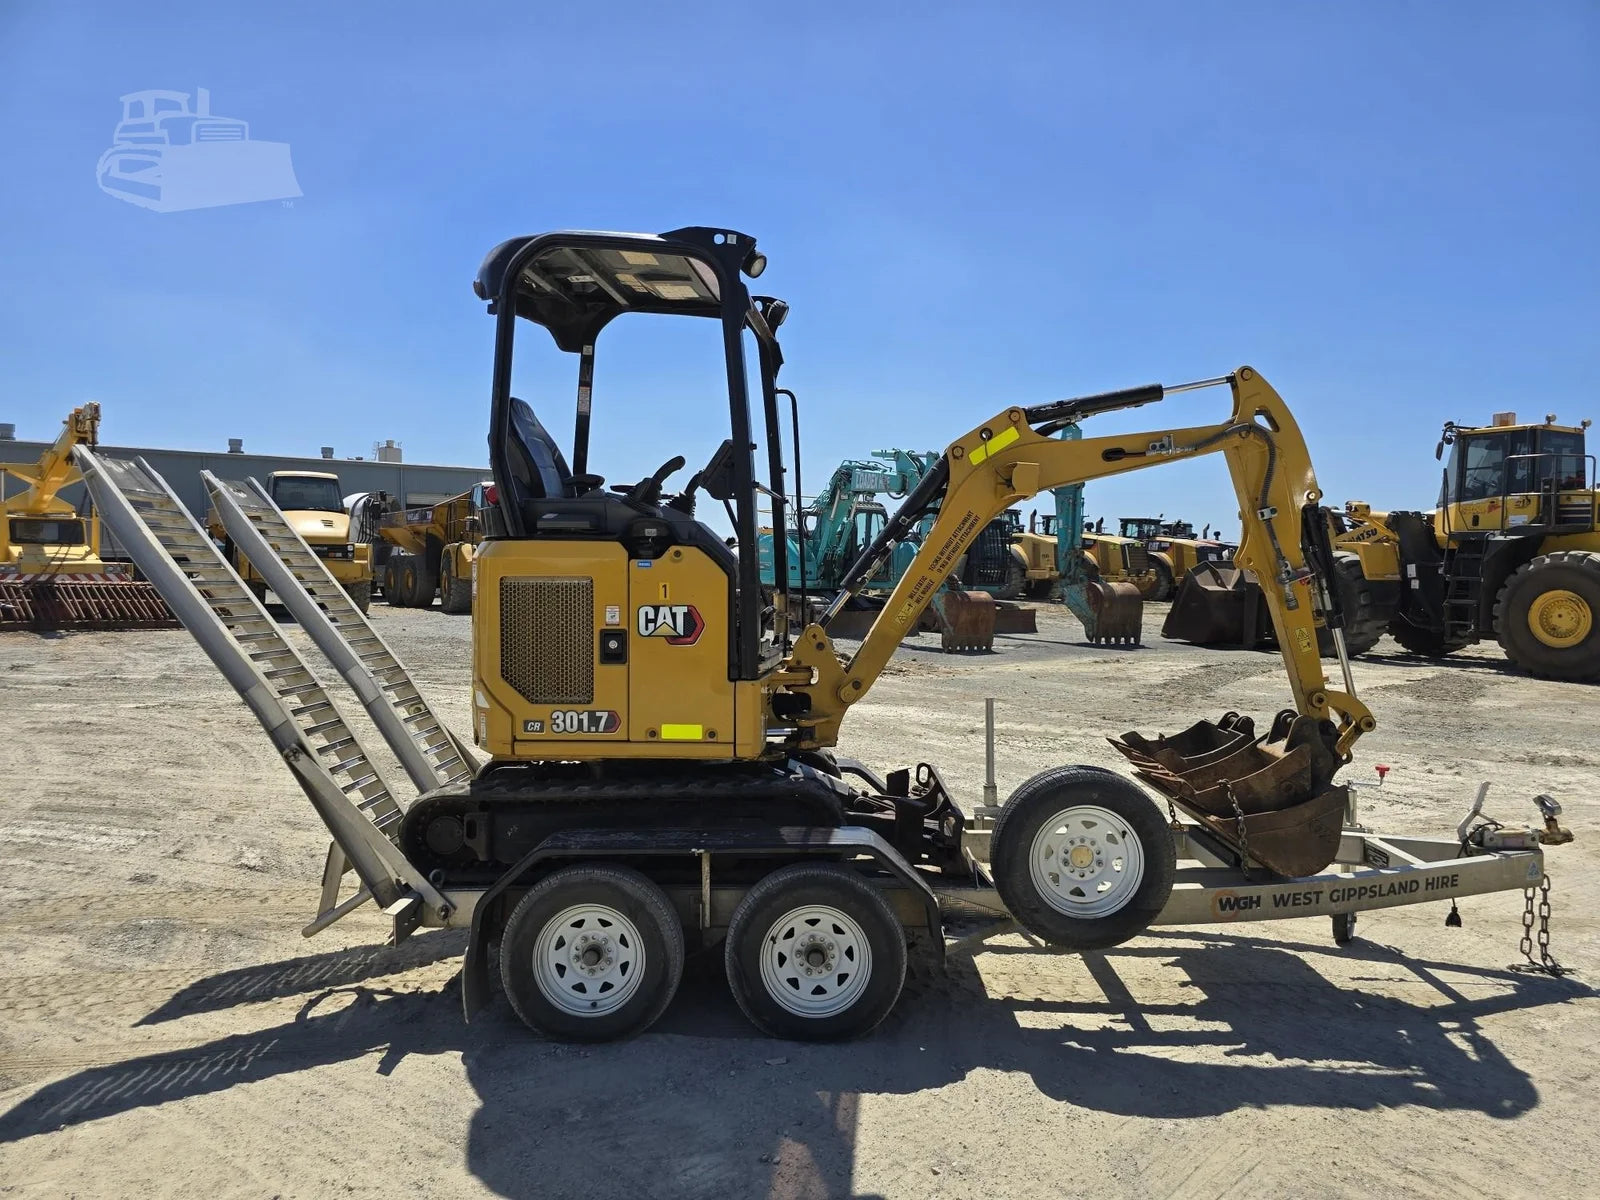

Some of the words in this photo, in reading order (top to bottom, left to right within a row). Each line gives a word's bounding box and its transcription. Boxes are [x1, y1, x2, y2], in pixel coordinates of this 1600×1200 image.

[952, 510, 975, 539] ATTACHMENT
[958, 515, 981, 543] ATTACHMENT
[662, 584, 667, 599] 1
[638, 605, 688, 637] CAT
[527, 721, 541, 731] CR
[551, 710, 609, 733] 301.7
[1218, 895, 1262, 912] WGH
[1272, 890, 1324, 908] WEST
[1329, 879, 1420, 903] GIPPSLAND
[1425, 874, 1460, 891] HIRE
